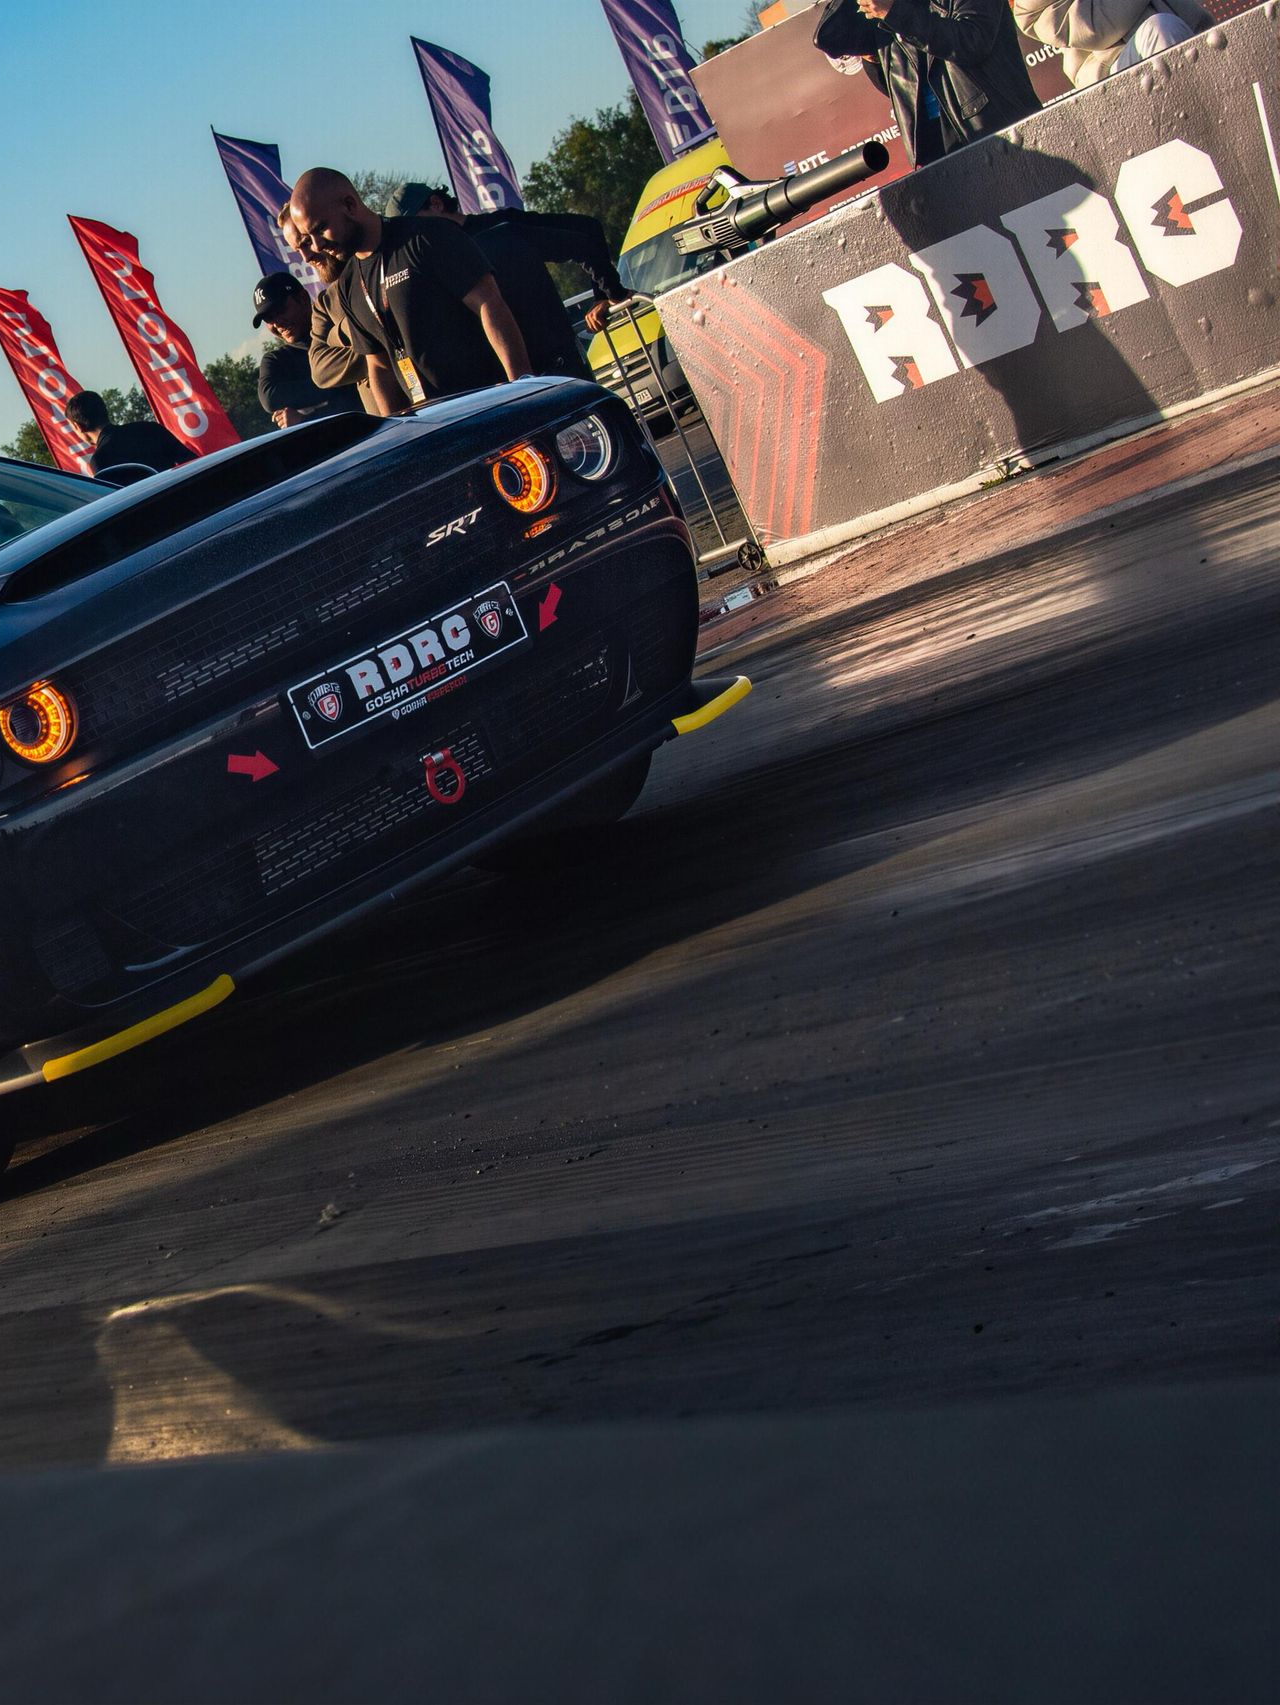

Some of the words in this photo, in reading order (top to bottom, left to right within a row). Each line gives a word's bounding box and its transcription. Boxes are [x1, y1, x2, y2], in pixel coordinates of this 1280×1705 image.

[642, 33, 700, 115] ВТБ
[822, 138, 1243, 404] RDRC
[104, 251, 209, 438] auto.ru
[425, 506, 483, 547] SRT
[344, 614, 471, 700] RDRC
